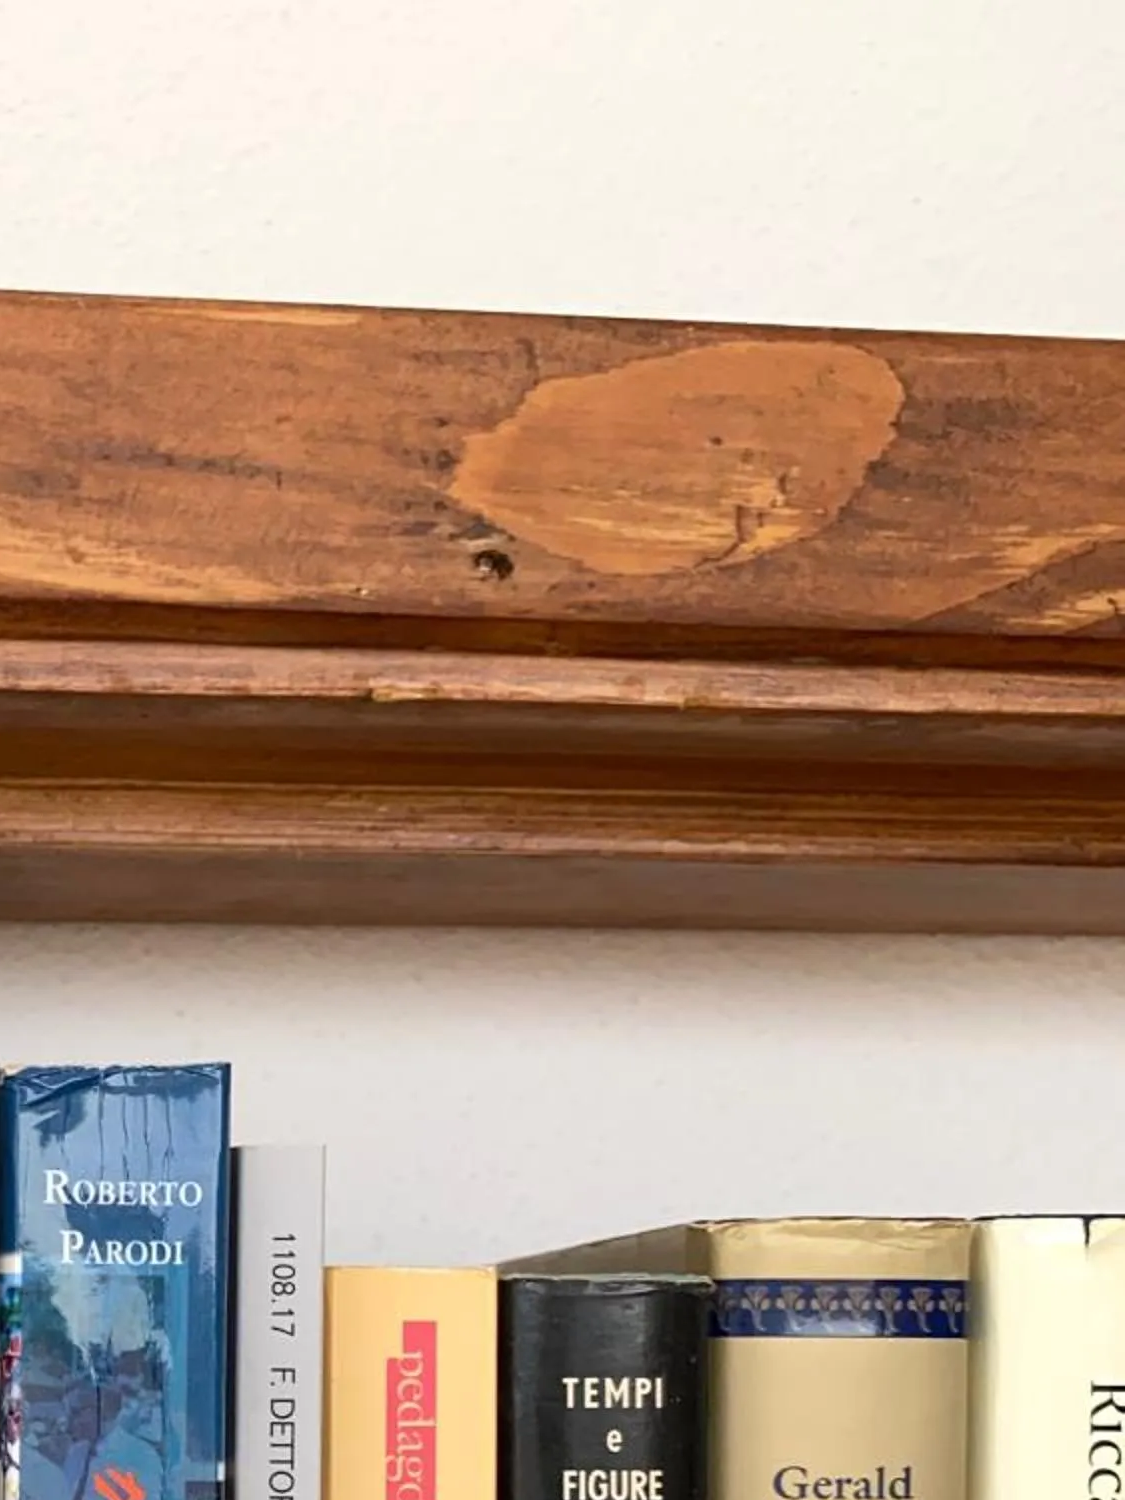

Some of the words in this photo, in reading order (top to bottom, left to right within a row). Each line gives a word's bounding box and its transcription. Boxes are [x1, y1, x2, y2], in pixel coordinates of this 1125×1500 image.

[42, 1169, 203, 1208] ROBERTO
[59, 1231, 184, 1267] PARODI
[270, 1232, 295, 1336] 1108.17
[270, 1367, 295, 1387] F.
[562, 1377, 664, 1409] TEMPI
[607, 1428, 623, 1453] e
